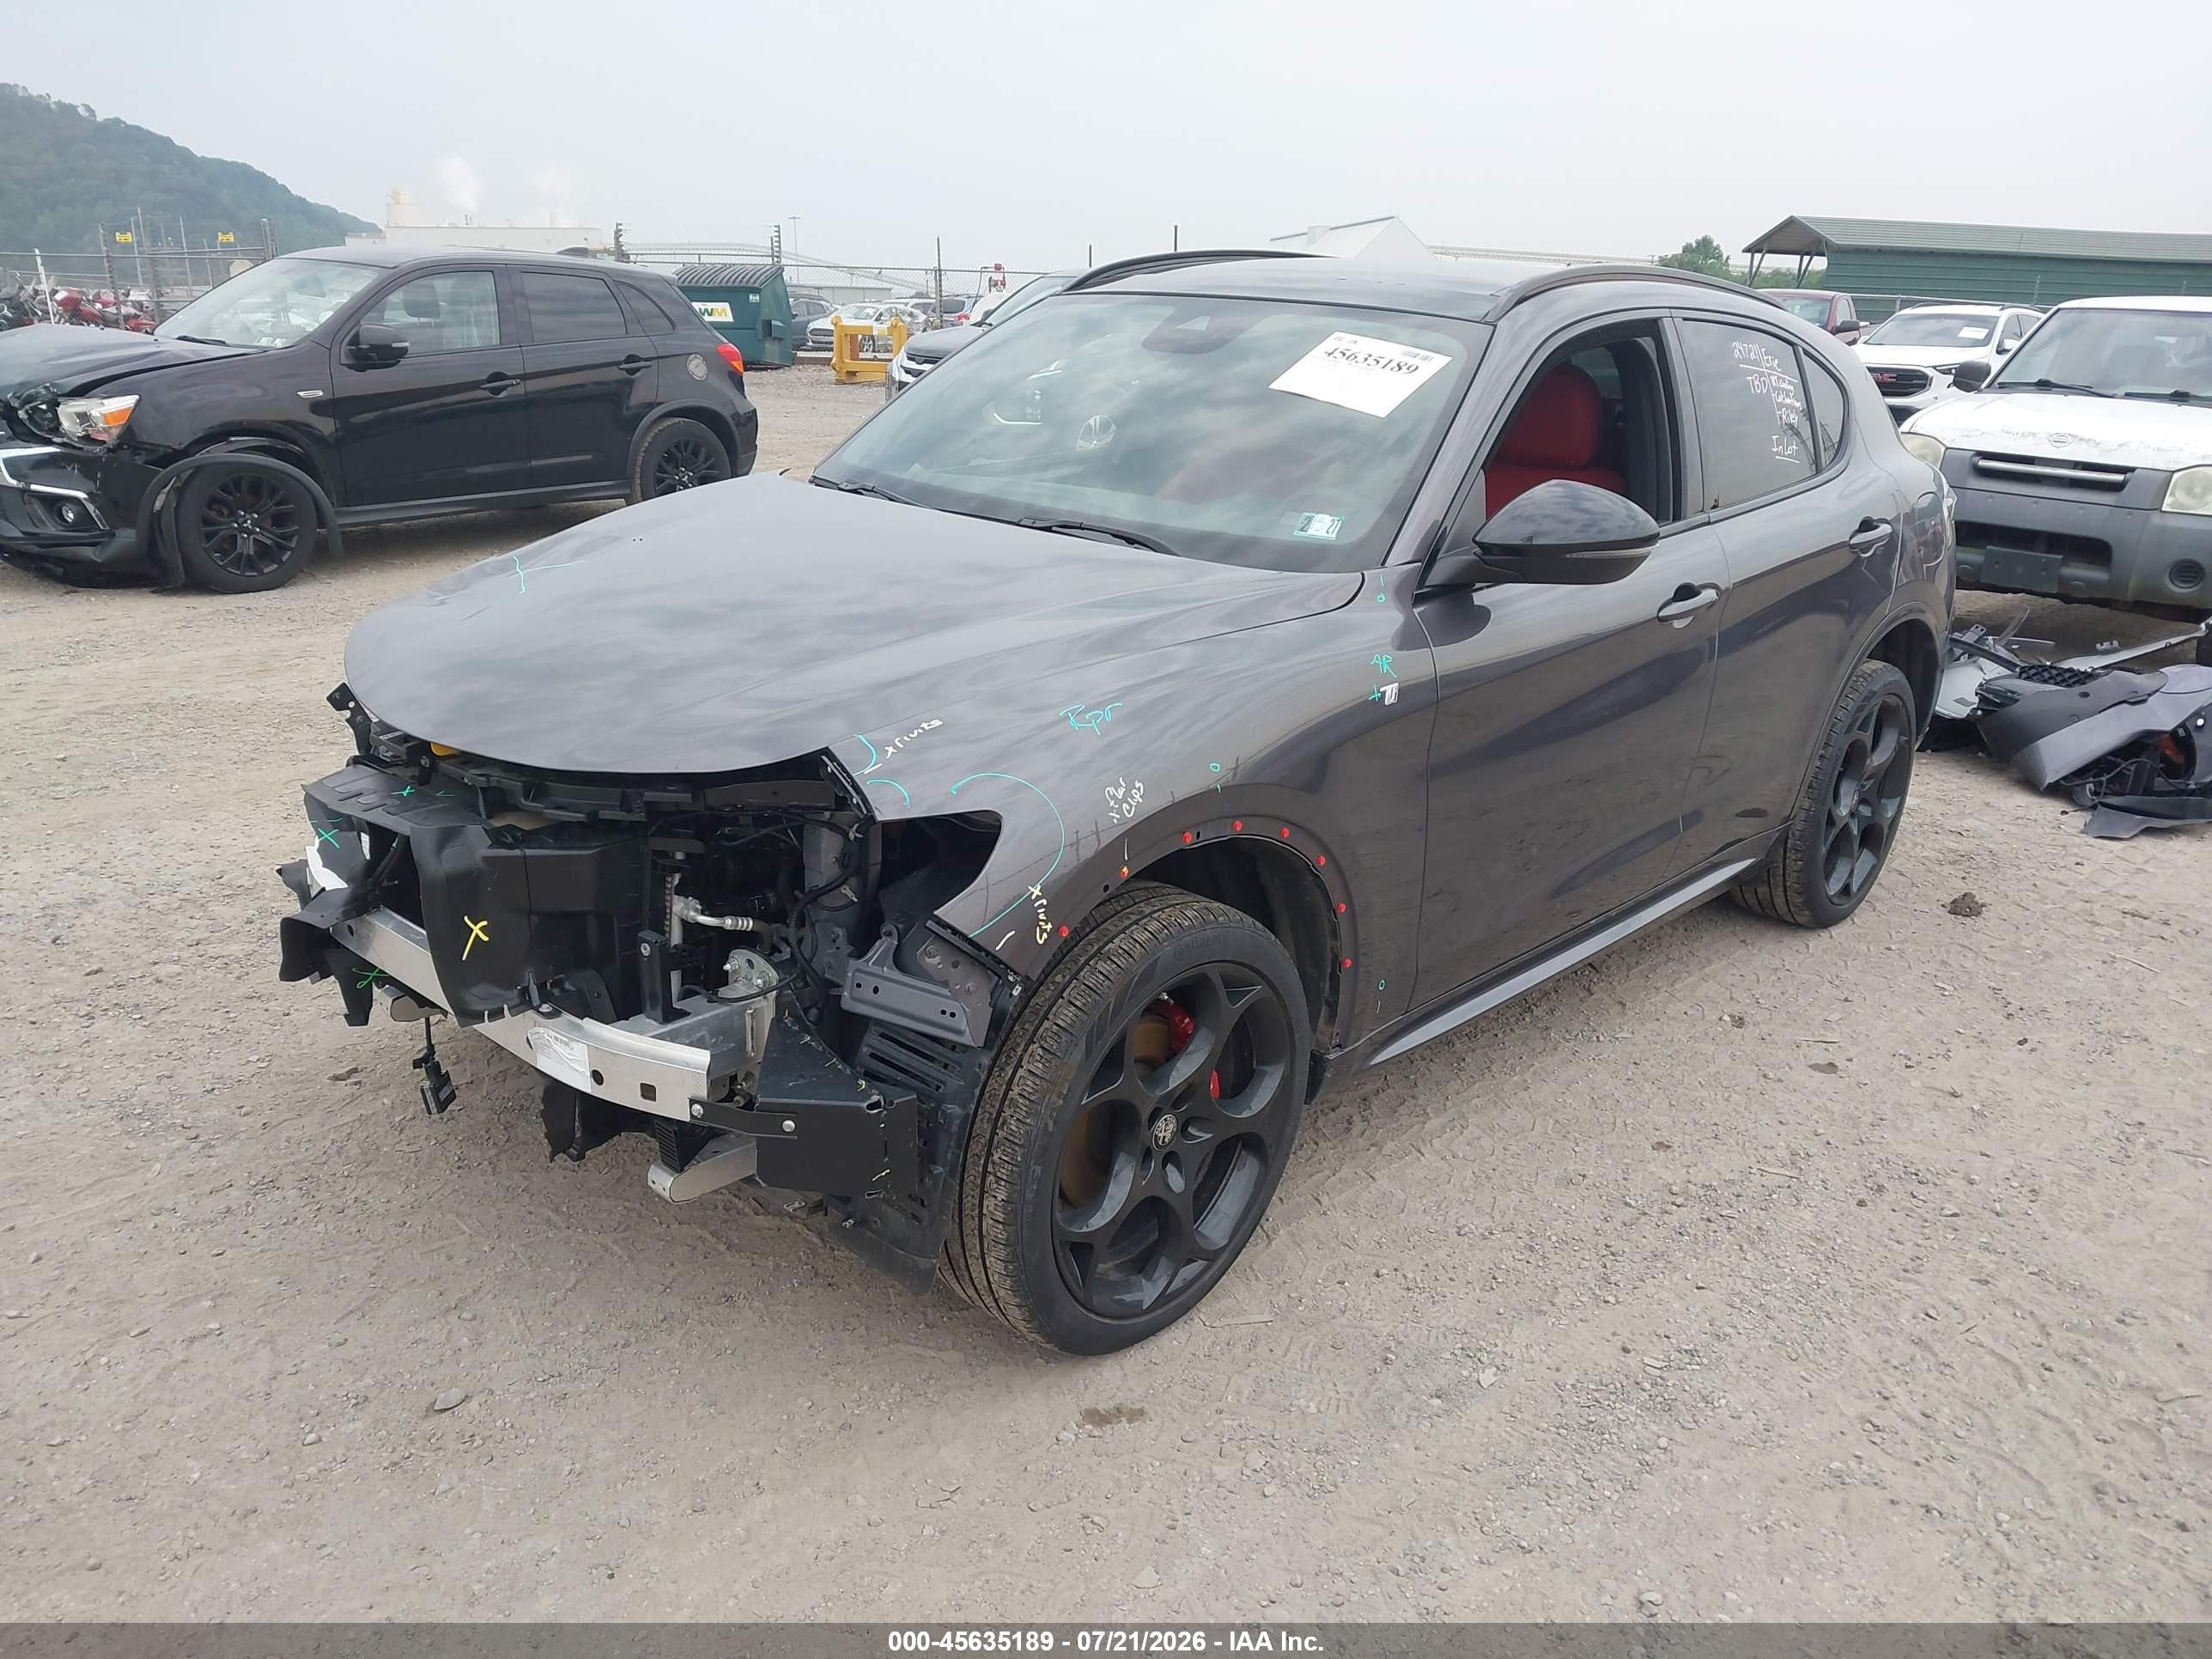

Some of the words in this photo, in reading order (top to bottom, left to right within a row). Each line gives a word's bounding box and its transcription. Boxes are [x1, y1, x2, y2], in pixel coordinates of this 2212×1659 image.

[698, 307, 727, 317] WM
[1324, 347, 1419, 374] 45635189
[1747, 374, 1769, 393] TBD
[1326, 519, 1340, 535] 27
